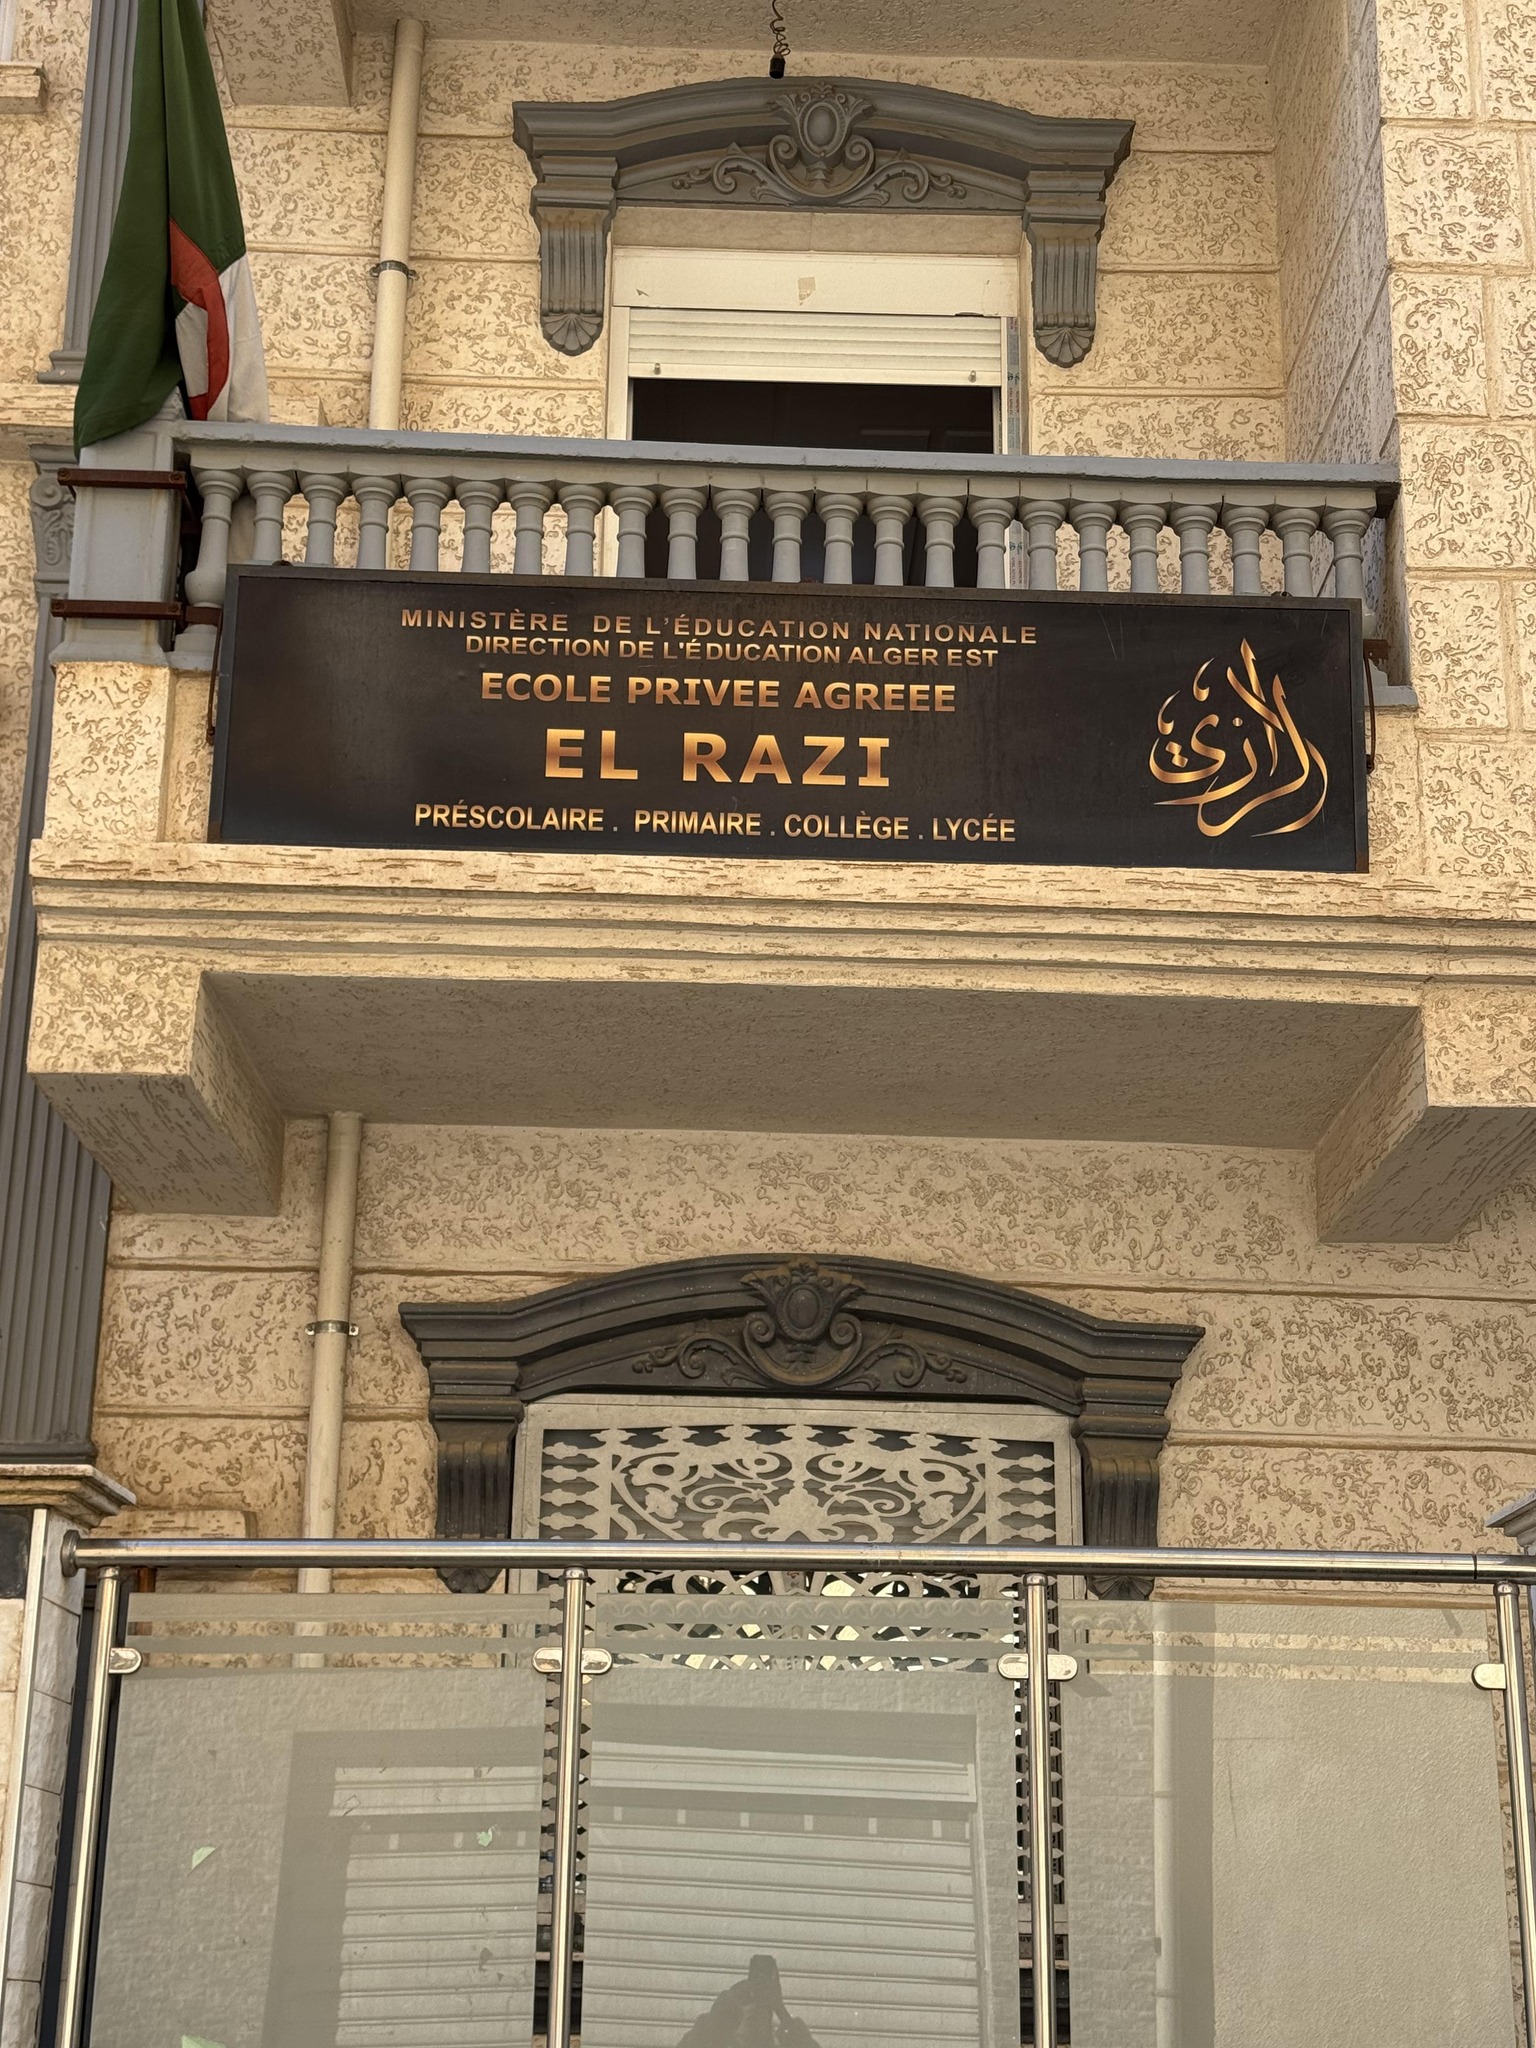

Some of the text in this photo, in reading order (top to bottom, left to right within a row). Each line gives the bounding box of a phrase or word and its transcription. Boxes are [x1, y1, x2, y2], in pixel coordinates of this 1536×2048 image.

[401, 608, 568, 632] MINISTÈRE
[593, 615, 632, 634] DE
[864, 622, 1037, 644] NATIONALE
[465, 635, 610, 657] DIRECTION
[619, 639, 655, 659] DE
[847, 646, 939, 666] ALGER
[946, 648, 999, 667] EST
[481, 671, 956, 712] ECOLE PRIVEE AGREEE
[544, 727, 890, 788] EL RAZI
[415, 799, 604, 832] PRÉSCOLAIRE
[634, 809, 762, 836] PRIMAIRE
[784, 810, 910, 840] COLLÈGE
[932, 812, 1016, 842] LYCÉE
